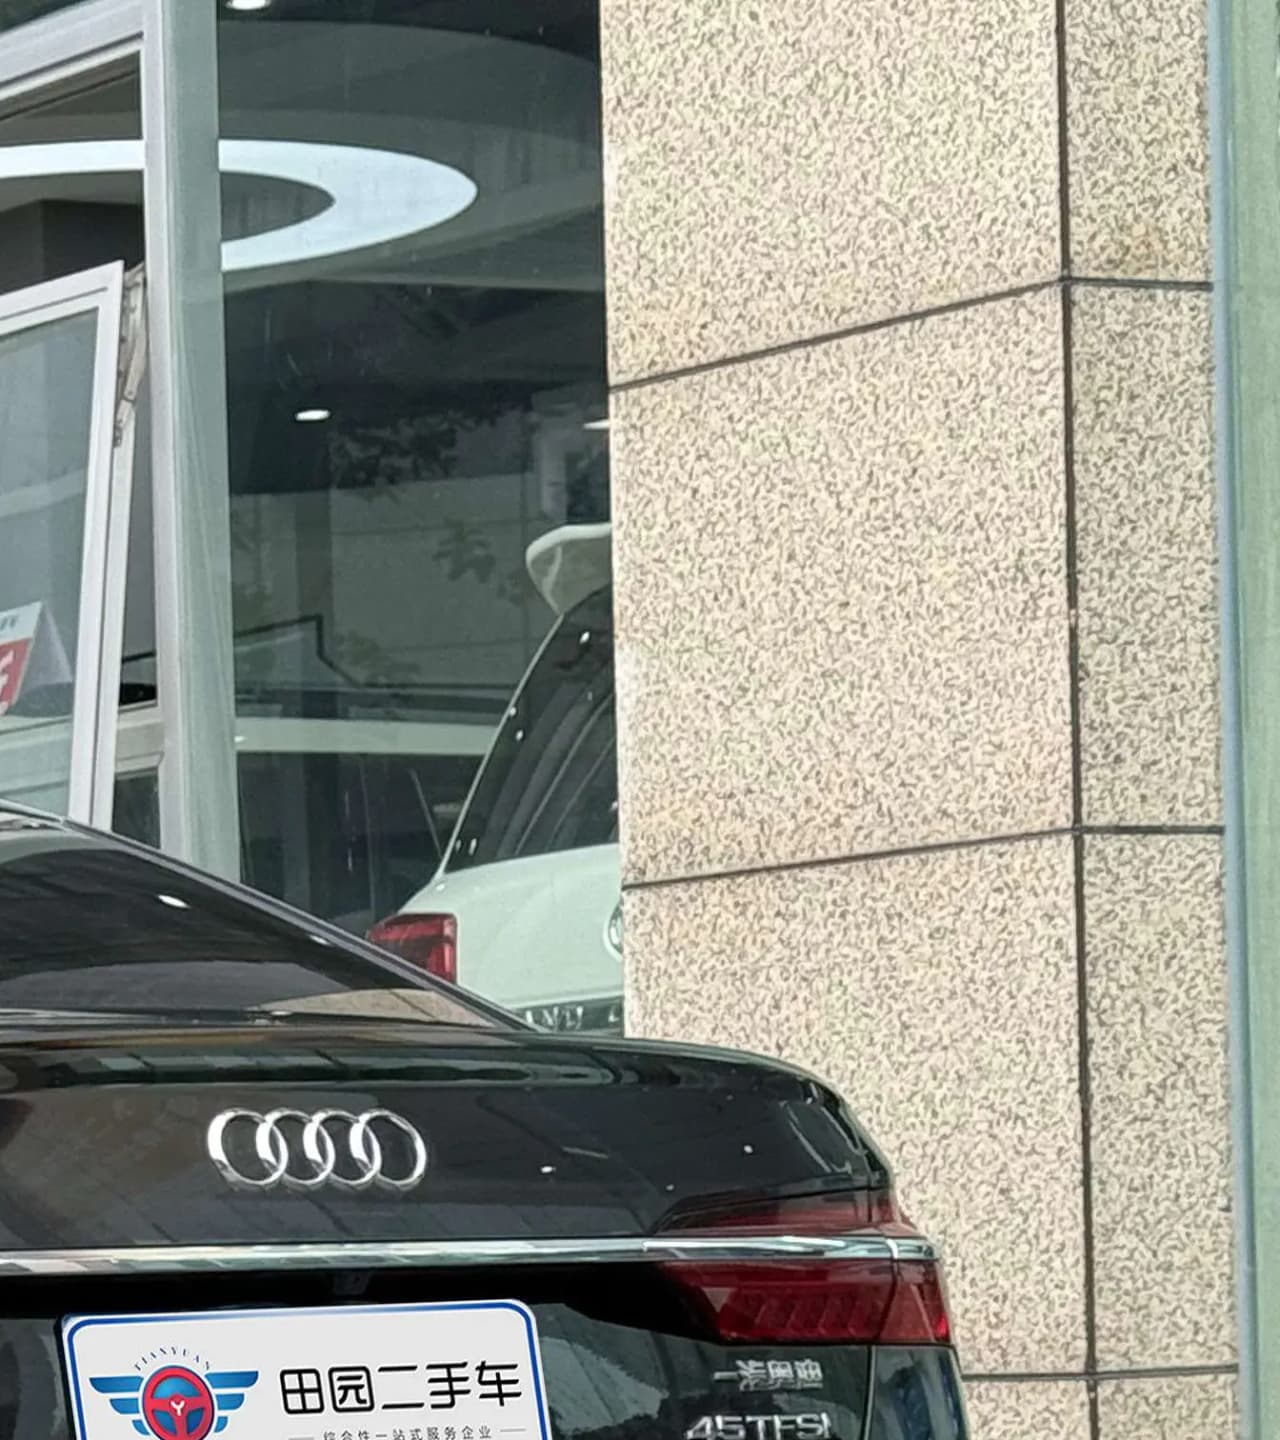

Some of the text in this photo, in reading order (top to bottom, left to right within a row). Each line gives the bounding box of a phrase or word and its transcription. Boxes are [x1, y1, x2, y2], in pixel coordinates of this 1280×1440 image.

[279, 1360, 523, 1415] 田园二手车
